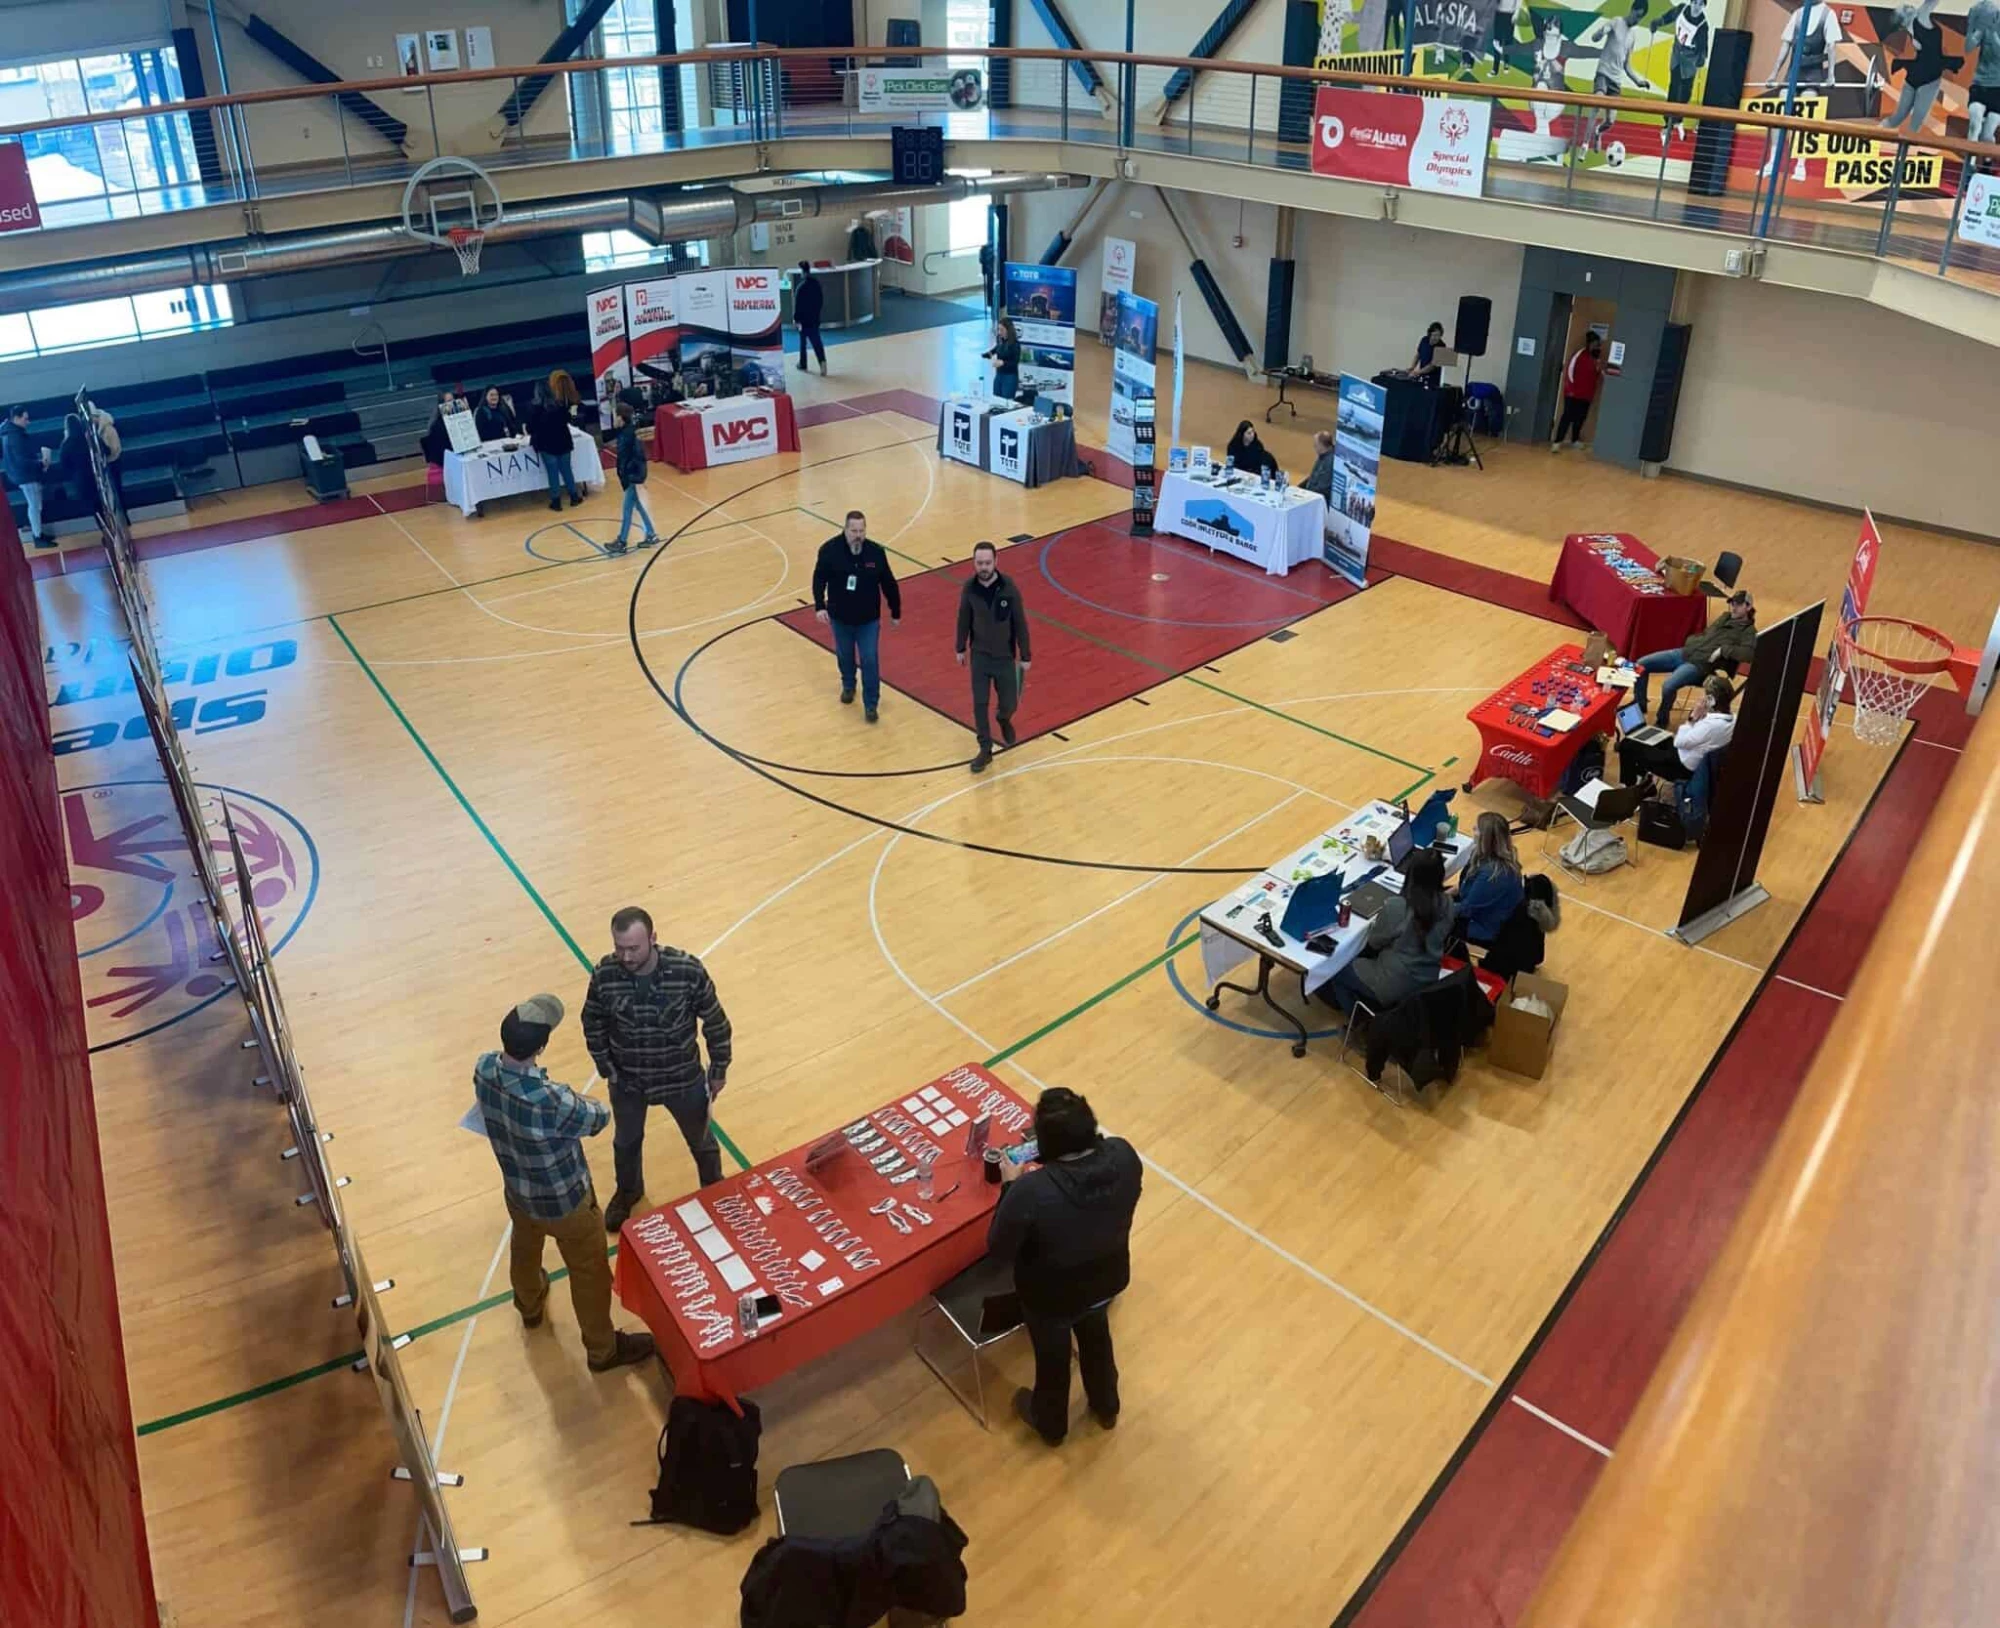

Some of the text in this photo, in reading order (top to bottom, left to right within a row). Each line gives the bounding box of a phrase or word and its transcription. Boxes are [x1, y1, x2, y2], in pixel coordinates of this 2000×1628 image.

[1414, 3, 1477, 33] ALASKA
[1797, 132, 1819, 154] IS
[1432, 151, 1470, 164] Special
[1426, 162, 1473, 176] Olympics
[1834, 160, 1933, 185] PASSON
[0, 203, 33, 222] sed
[953, 439, 972, 453] TOTE
[1000, 456, 1019, 470] TOTE
